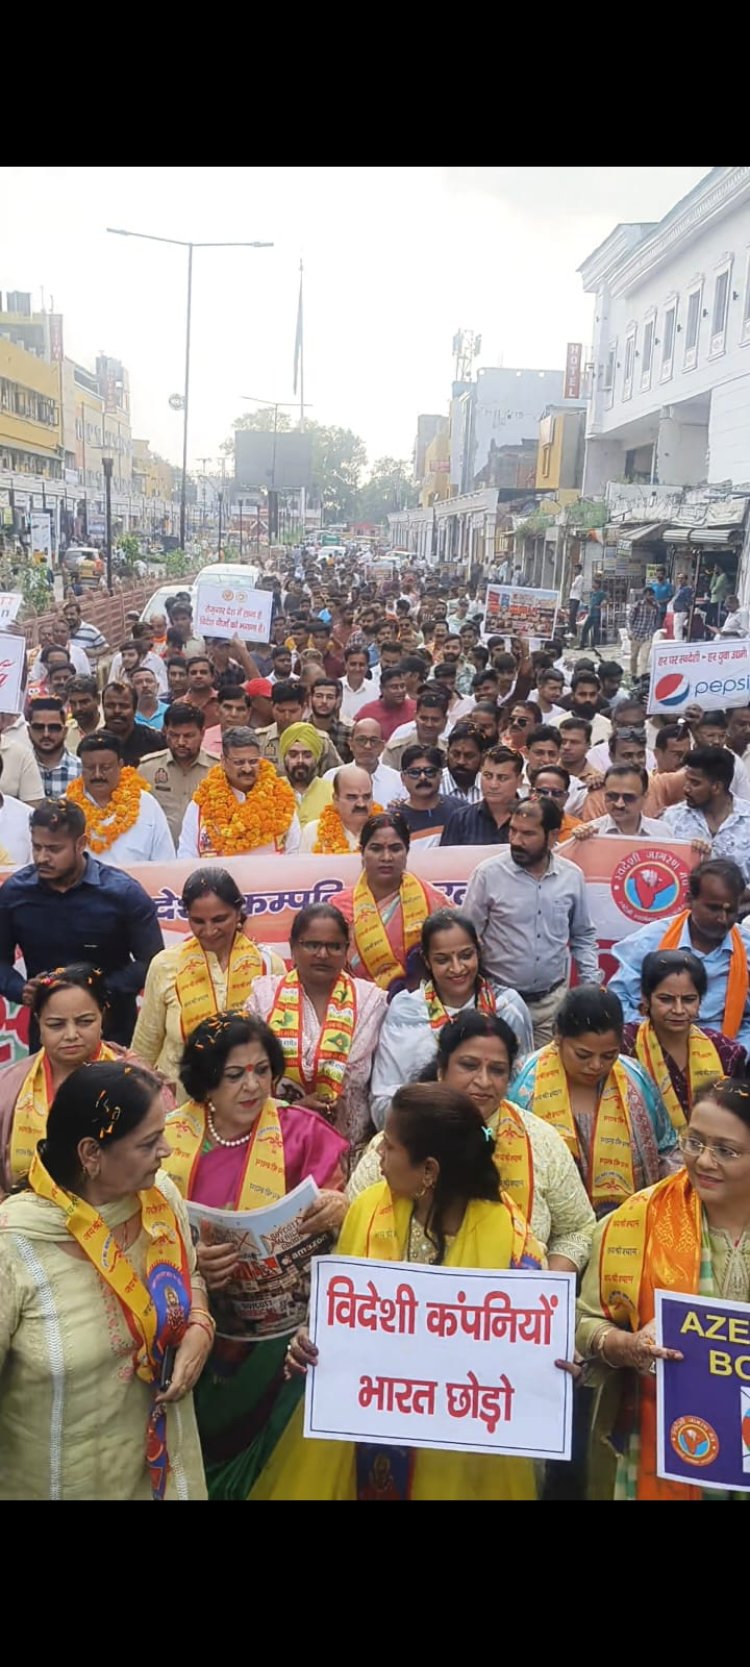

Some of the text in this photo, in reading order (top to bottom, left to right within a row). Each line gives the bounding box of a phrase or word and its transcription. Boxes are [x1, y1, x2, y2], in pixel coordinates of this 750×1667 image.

[569, 344, 579, 397] HOTEL
[694, 674, 750, 697] pepsi
[327, 1275, 558, 1345] विदेशी कंपनियों
[358, 1371, 514, 1434] भारत छोड़ो
